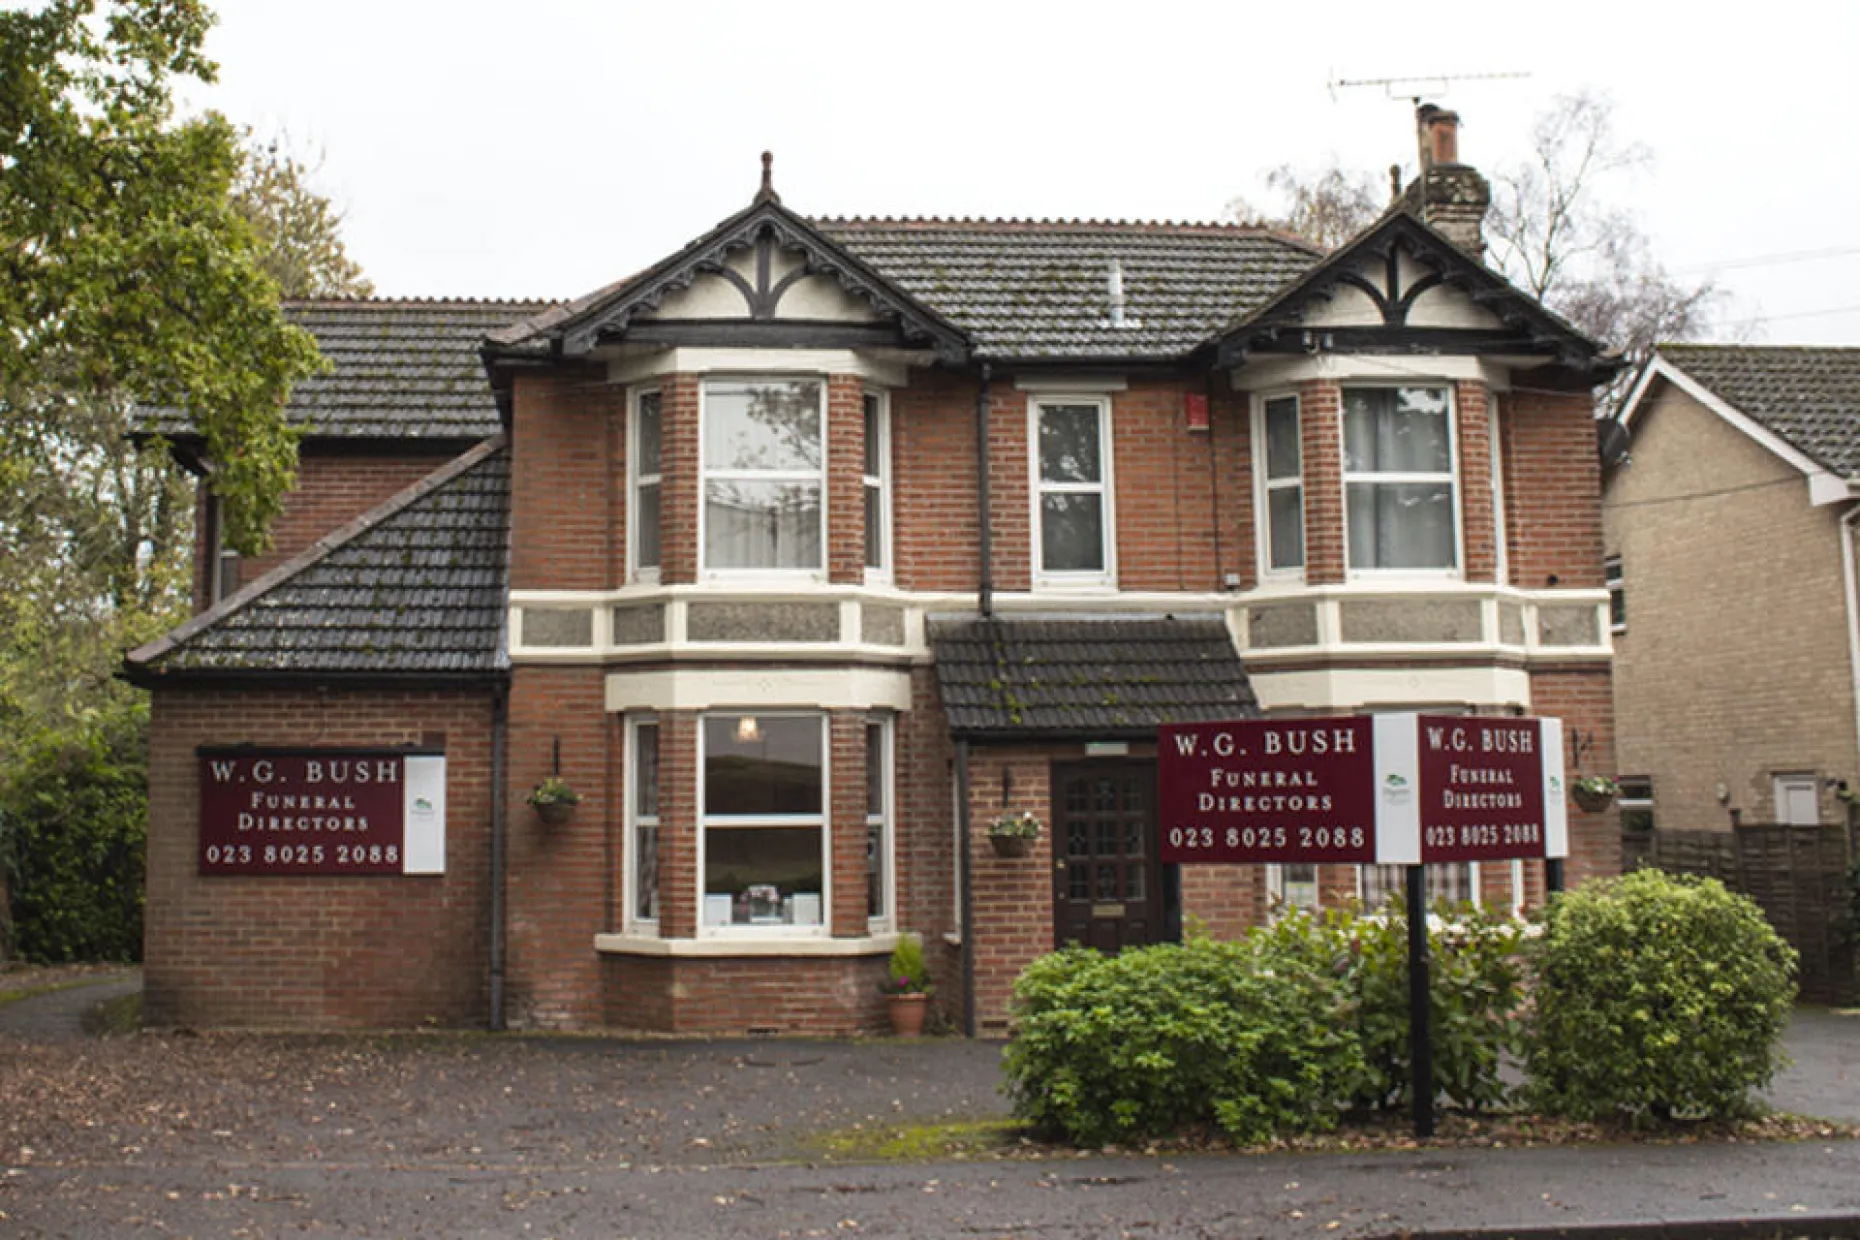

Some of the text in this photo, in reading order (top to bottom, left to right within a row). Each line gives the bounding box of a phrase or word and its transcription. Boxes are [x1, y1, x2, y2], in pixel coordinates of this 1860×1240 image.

[1174, 728, 1355, 756] W.G. BUSH
[1426, 726, 1533, 753] W.G. BUSH
[210, 760, 397, 783] W.G. BUSH
[1210, 768, 1318, 787] FUNERAL
[1450, 763, 1514, 784] FUNERAL
[251, 791, 356, 809] FUNERAL
[1199, 793, 1332, 811] DIRECTORS
[238, 813, 369, 831] DIRECTORS
[1169, 826, 1365, 848] 023 8025 2088
[1425, 826, 1455, 847] 023
[206, 845, 399, 864] 023 8025 2088
